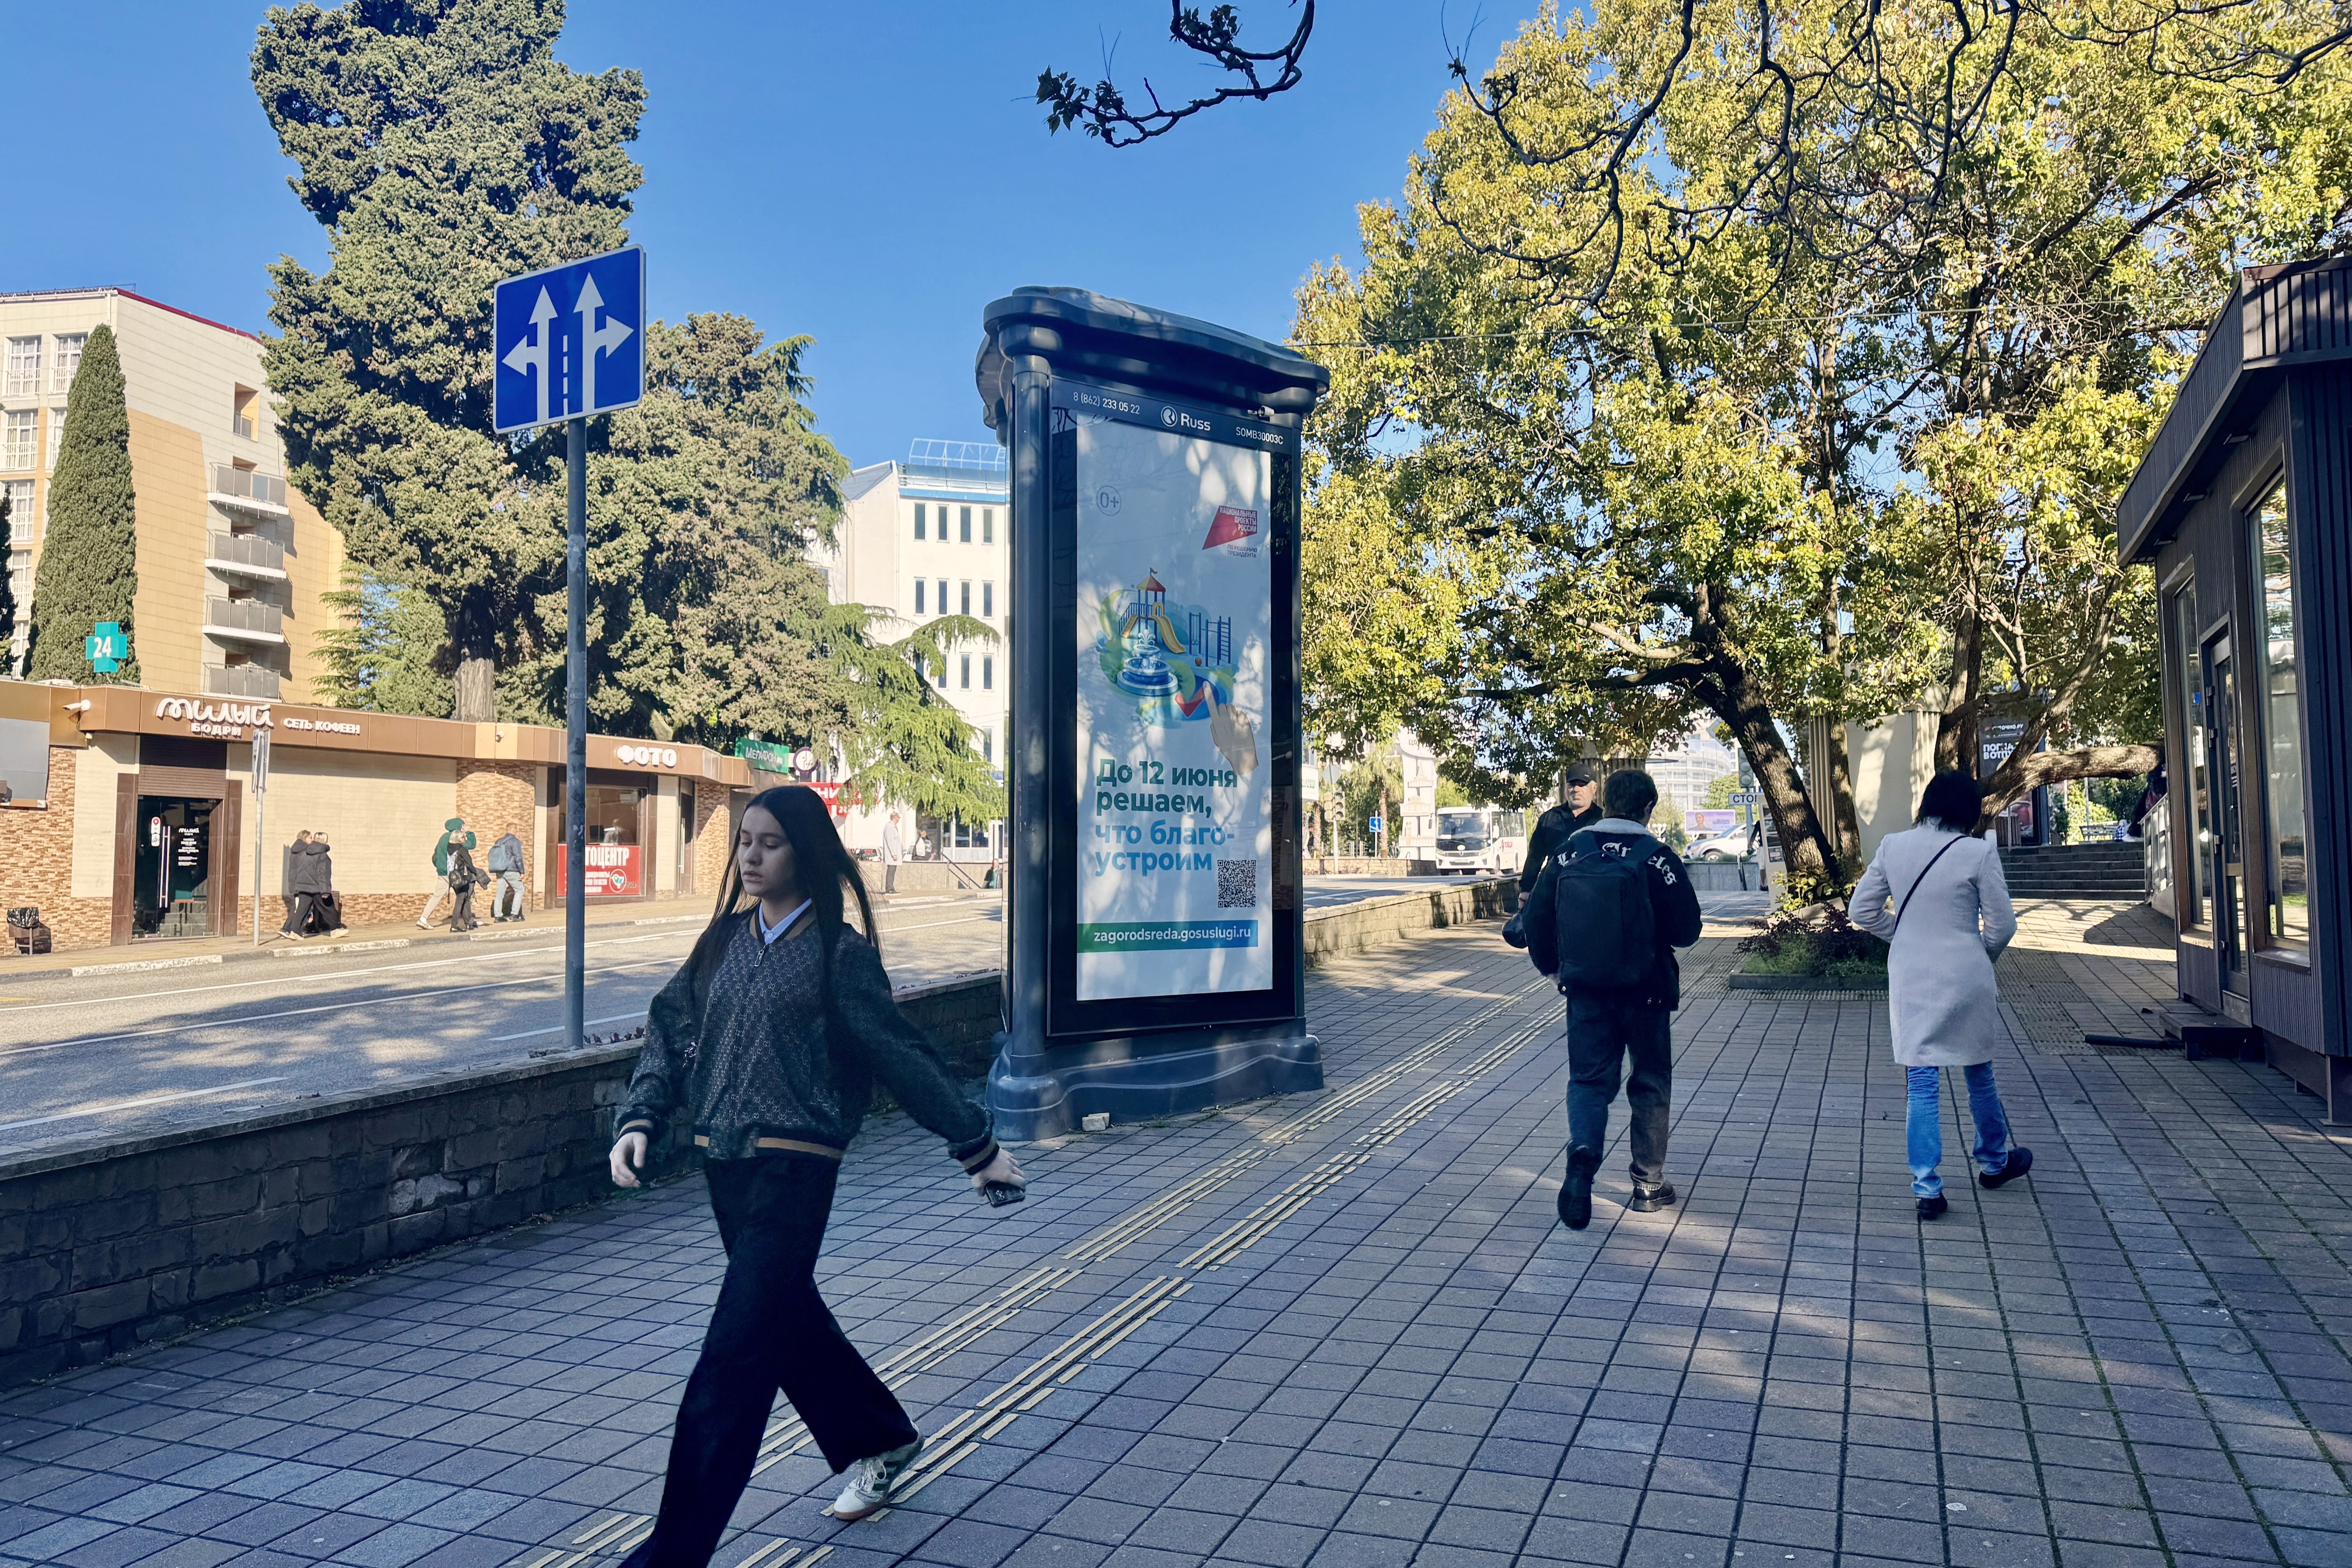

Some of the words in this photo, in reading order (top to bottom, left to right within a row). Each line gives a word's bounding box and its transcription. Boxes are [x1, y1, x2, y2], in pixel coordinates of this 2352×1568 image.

[1073, 392, 1078, 401] 8
[1080, 393, 1100, 407] (862)
[1102, 397, 1117, 410] 233
[1118, 401, 1129, 412] 05
[1130, 404, 1140, 415] 22
[1181, 413, 1211, 431] Russ
[1100, 492, 1119, 509] 0+
[1220, 506, 1257, 518] НАЦИОНАЛЬНЫЕ
[1234, 516, 1257, 525] ПРОЕКТЫ
[1238, 524, 1257, 532] РОССИИ
[93, 636, 112, 658] 24
[191, 723, 241, 736] БОДРИ
[283, 718, 313, 730] СЕТЬ
[315, 720, 360, 735] КОФЕЕН
[617, 745, 677, 767] ФОТО
[1096, 759, 1133, 787] До
[1139, 761, 1164, 785] 12
[1172, 767, 1237, 788] июня
[1096, 790, 1212, 818] решаем,
[1733, 794, 1757, 803] СТО
[1095, 825, 1141, 844] что
[1150, 819, 1235, 845] благо-
[585, 846, 630, 869] ТОЦЕНТР
[1095, 850, 1212, 876] устроим
[1094, 926, 1251, 944] zagorodsreda.gosuslugi.ru
